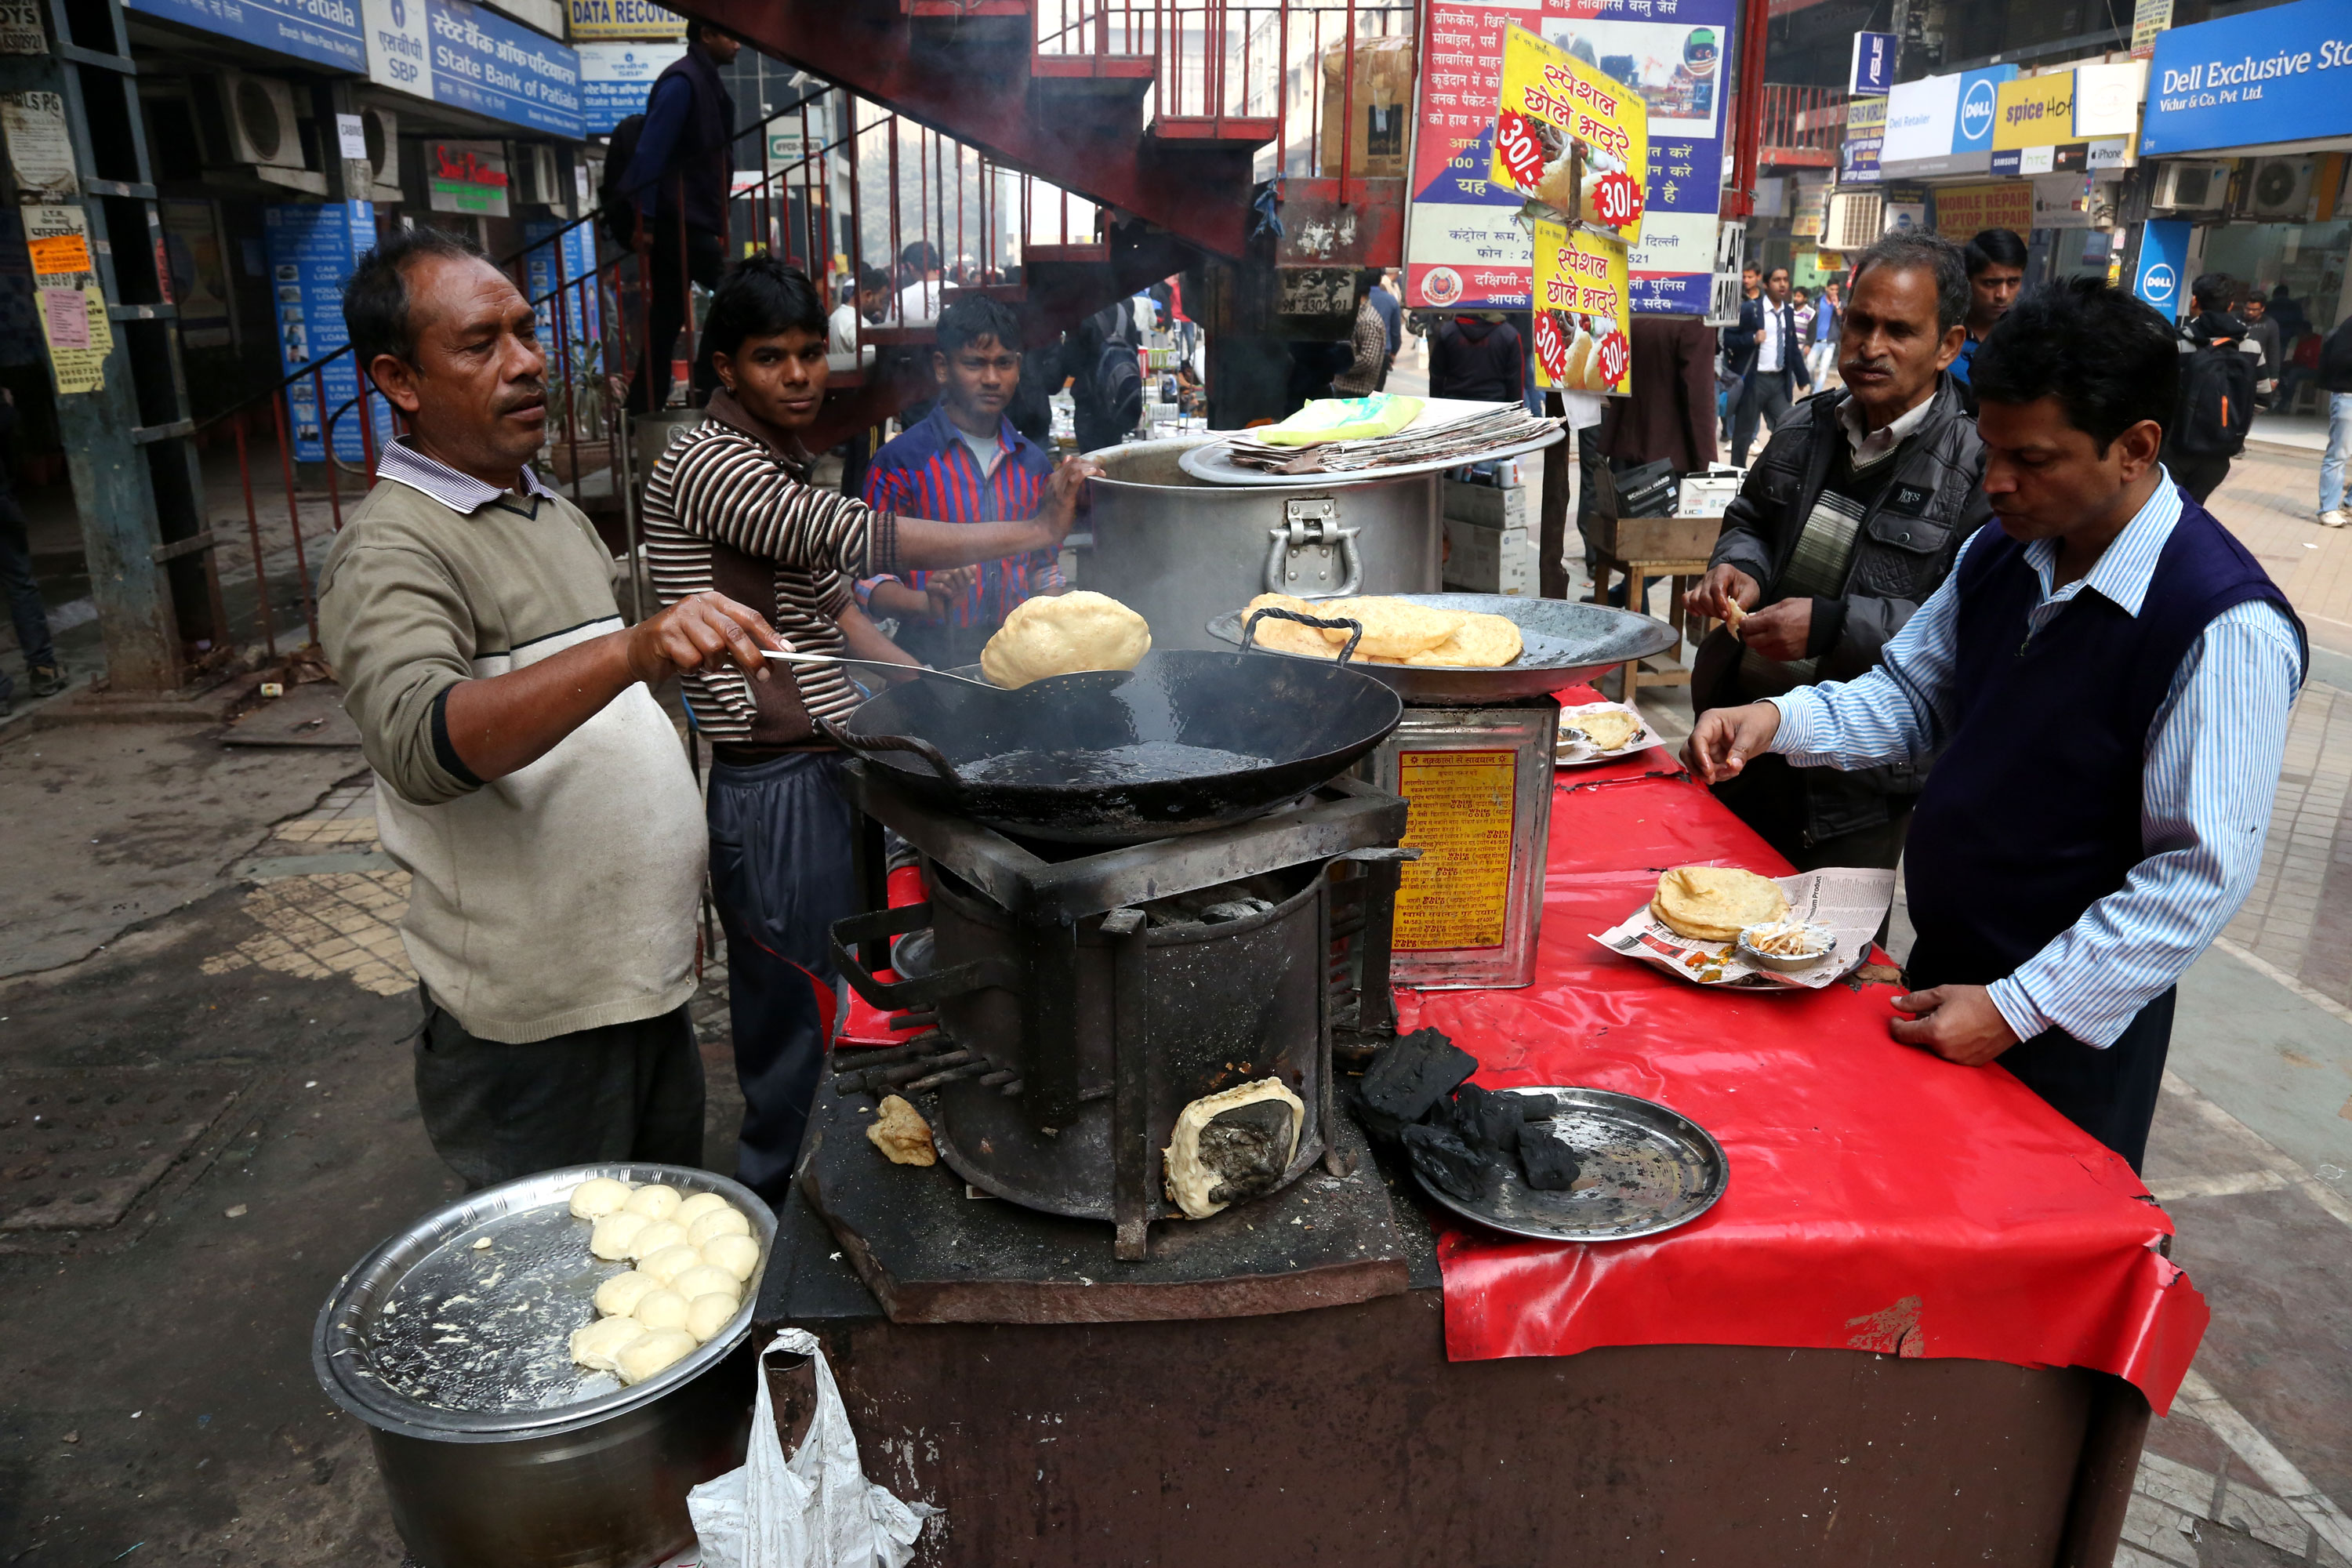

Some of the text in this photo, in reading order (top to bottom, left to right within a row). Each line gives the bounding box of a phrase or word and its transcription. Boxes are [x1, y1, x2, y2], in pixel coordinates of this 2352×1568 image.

[573, 1, 611, 24] DATA
[1628, 0, 1652, 17] वस्तु
[1434, 9, 1479, 28] ब्रीफकेस,
[378, 30, 423, 61] एसबीपी
[433, 9, 576, 86] स्टेट बैंक ऑफ पटियाला
[1480, 33, 1497, 48] पर्स
[1432, 51, 1474, 67] लावारिस
[1870, 36, 1884, 85] ASUS
[389, 58, 419, 83] SBP
[436, 45, 580, 111] State Bank of Patiala
[1472, 71, 1481, 87] में
[2162, 64, 2203, 95] Dell
[2207, 50, 2311, 88] Exclusive
[1429, 93, 1457, 106] जनक
[1544, 64, 1618, 119] स्पेशल
[2160, 85, 2263, 113] Vidur & Co. Pvt Ltd.
[42, 93, 60, 111] PG
[1523, 85, 1574, 128] छोले
[1965, 101, 1991, 118] DELL
[1428, 108, 1443, 126] को
[1449, 114, 1468, 127] हाथ
[1472, 115, 1481, 127] न
[2005, 97, 2045, 126] spice
[340, 124, 364, 136] CABINS
[1889, 114, 1931, 129] Dell Retailer
[1449, 138, 1481, 150] आस
[1499, 118, 1540, 183] 30/-
[1668, 144, 1693, 158] करें
[1446, 158, 1474, 169] 100
[1994, 156, 2019, 166] SAMSUNG
[2025, 155, 2048, 166] htc
[2098, 149, 2122, 160] iPhone
[1456, 178, 1488, 197] यह
[1662, 180, 1679, 204] है
[1601, 181, 1640, 219] 30/-
[1937, 194, 1981, 210] MOBILE
[1986, 191, 2030, 209] REPAIR
[1939, 210, 2030, 227] LAPTOP REPAIR
[1449, 227, 1488, 244] कंट्रोल
[1645, 234, 1680, 248] दिल्ली
[1476, 245, 1503, 259] फोन
[1557, 241, 1608, 280] स्पेशल
[1628, 254, 1649, 263] 521
[1546, 273, 1579, 307] छोले
[1650, 278, 1686, 295] पुलिस
[2147, 277, 2172, 288] DELL
[1486, 291, 1527, 306] आपके
[1643, 294, 1673, 310] सदैव
[1536, 316, 1562, 375] 30/-
[1602, 336, 1628, 380] 30/-
[1813, 876, 1821, 898] Product
